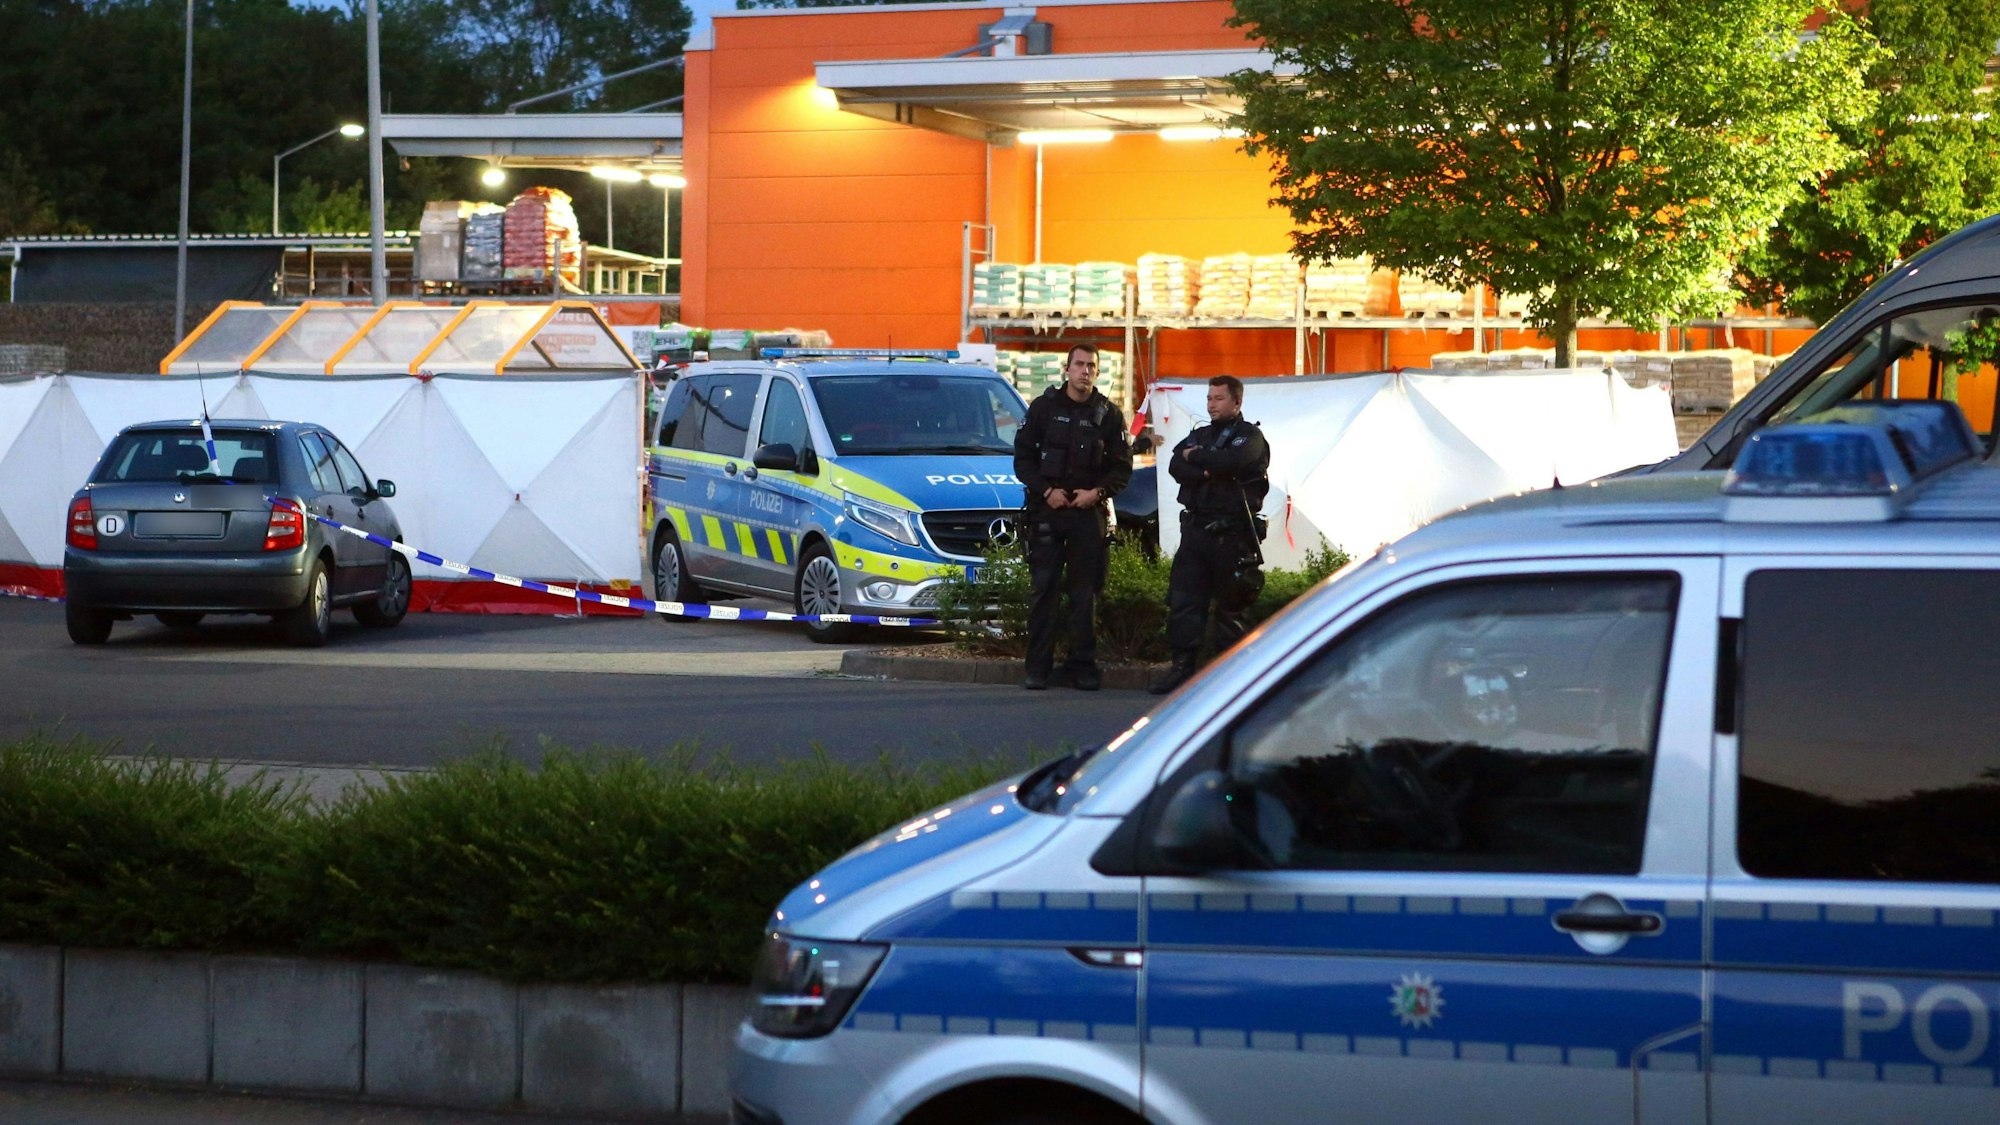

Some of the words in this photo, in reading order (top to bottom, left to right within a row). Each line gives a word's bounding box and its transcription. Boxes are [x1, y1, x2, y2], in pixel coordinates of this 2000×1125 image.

[656, 338, 679, 346] EHL
[749, 489, 783, 514] POLIZEI
[106, 518, 116, 533] D
